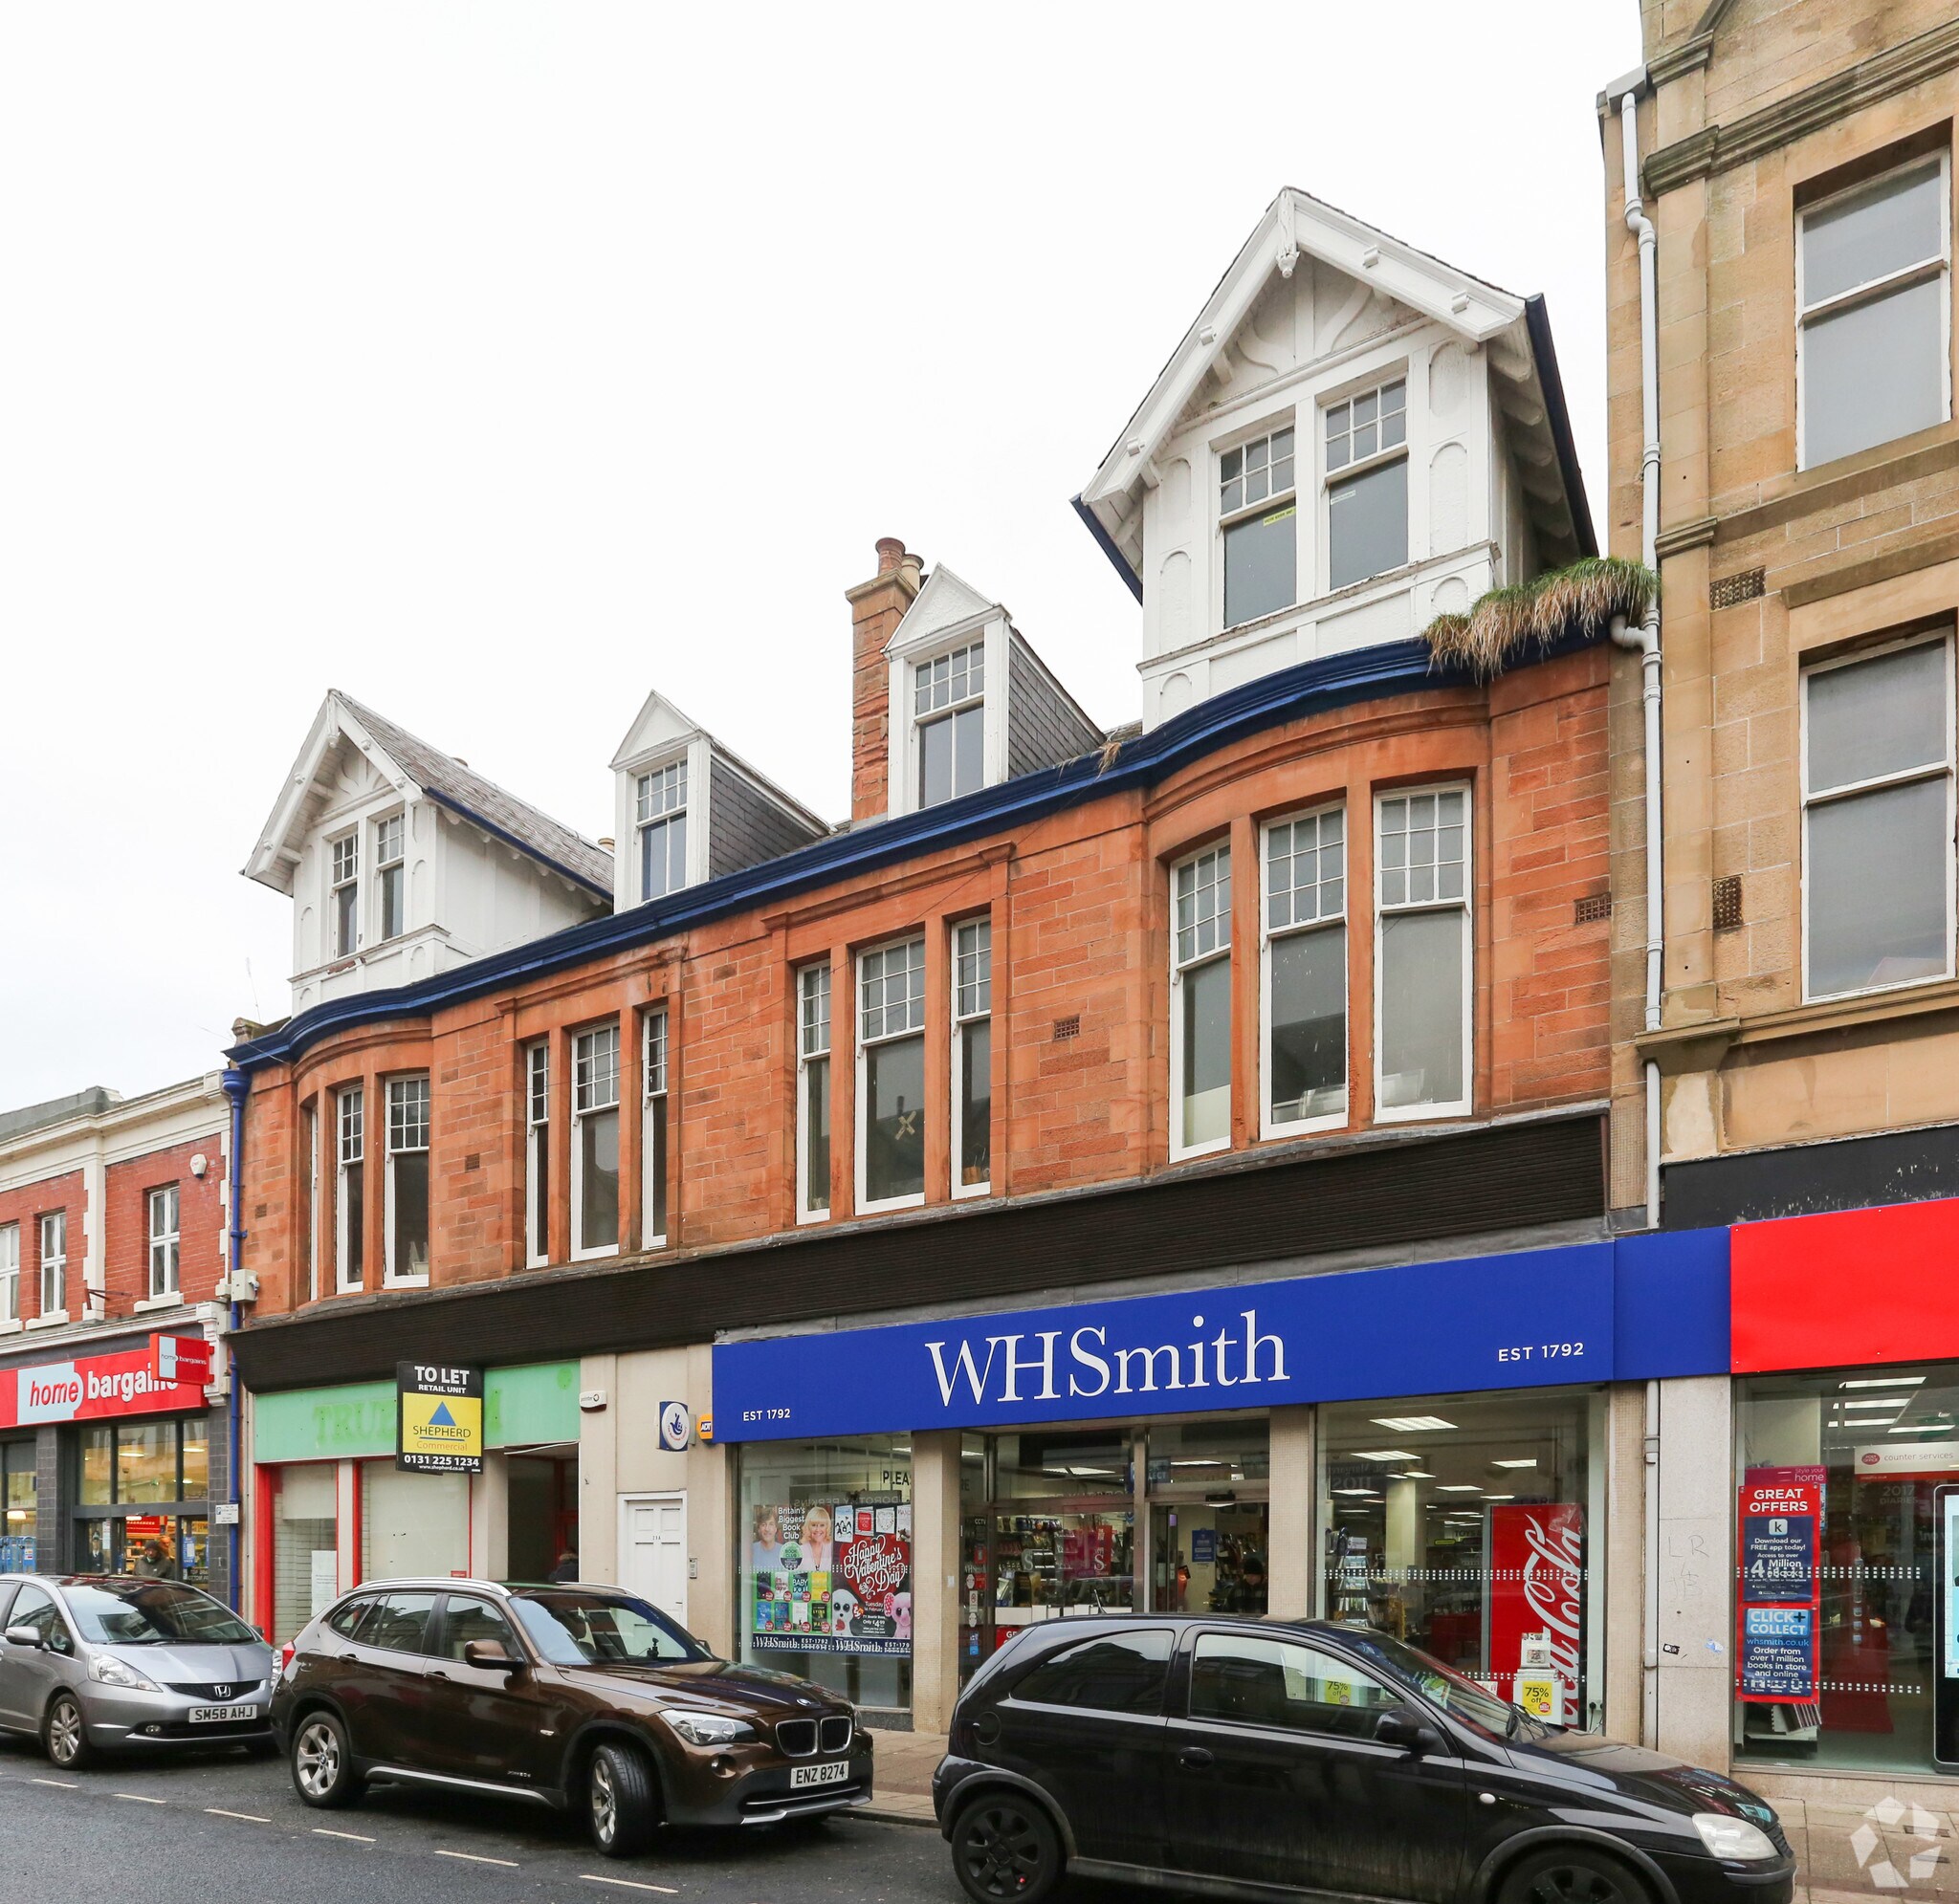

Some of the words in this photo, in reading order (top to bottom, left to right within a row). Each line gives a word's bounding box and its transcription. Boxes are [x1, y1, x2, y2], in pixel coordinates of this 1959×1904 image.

[1498, 1346, 1533, 1362] EST
[1541, 1342, 1584, 1358] 1792
[179, 1356, 207, 1365] bargains
[924, 1309, 1291, 1408] WHSmith
[414, 1366, 437, 1382] TO
[441, 1368, 470, 1385] LET
[30, 1380, 77, 1407] home
[418, 1384, 446, 1392] RETAIL
[743, 1411, 763, 1421] EST
[766, 1408, 791, 1419] 1792
[412, 1426, 472, 1438] SHEPHERD
[417, 1440, 468, 1452] Commercial
[404, 1455, 429, 1464] 0131
[432, 1456, 451, 1465] 225
[454, 1457, 479, 1467] 1234
[1883, 1453, 1916, 1461] counter
[1919, 1452, 1953, 1460] services
[883, 1470, 911, 1485] PLEA
[1754, 1488, 1804, 1499] GREAT
[1882, 1485, 1916, 1497] 2017
[1750, 1500, 1809, 1513] OFFERS
[1879, 1497, 1919, 1505] DIARIES
[778, 1506, 806, 1515] Britain's
[778, 1515, 806, 1523] Biggest
[844, 1534, 886, 1566] Happy
[844, 1547, 902, 1584] Valentine's
[1750, 1559, 1765, 1578] 4
[1769, 1559, 1802, 1567] Million
[874, 1563, 906, 1592] Day
[1750, 1624, 1806, 1635] COLLECT
[756, 1636, 798, 1649] WHSmith
[835, 1639, 881, 1652] WHSmith
[1747, 1638, 1810, 1647] whsmith.co.uk
[1780, 1647, 1801, 1655] from
[1328, 1680, 1349, 1691] 75%
[1525, 1687, 1550, 1698] 75%
[195, 1708, 228, 1720] SM58
[231, 1707, 253, 1718] AHJ
[796, 1768, 818, 1784] ENZ
[820, 1763, 845, 1782] 8274
